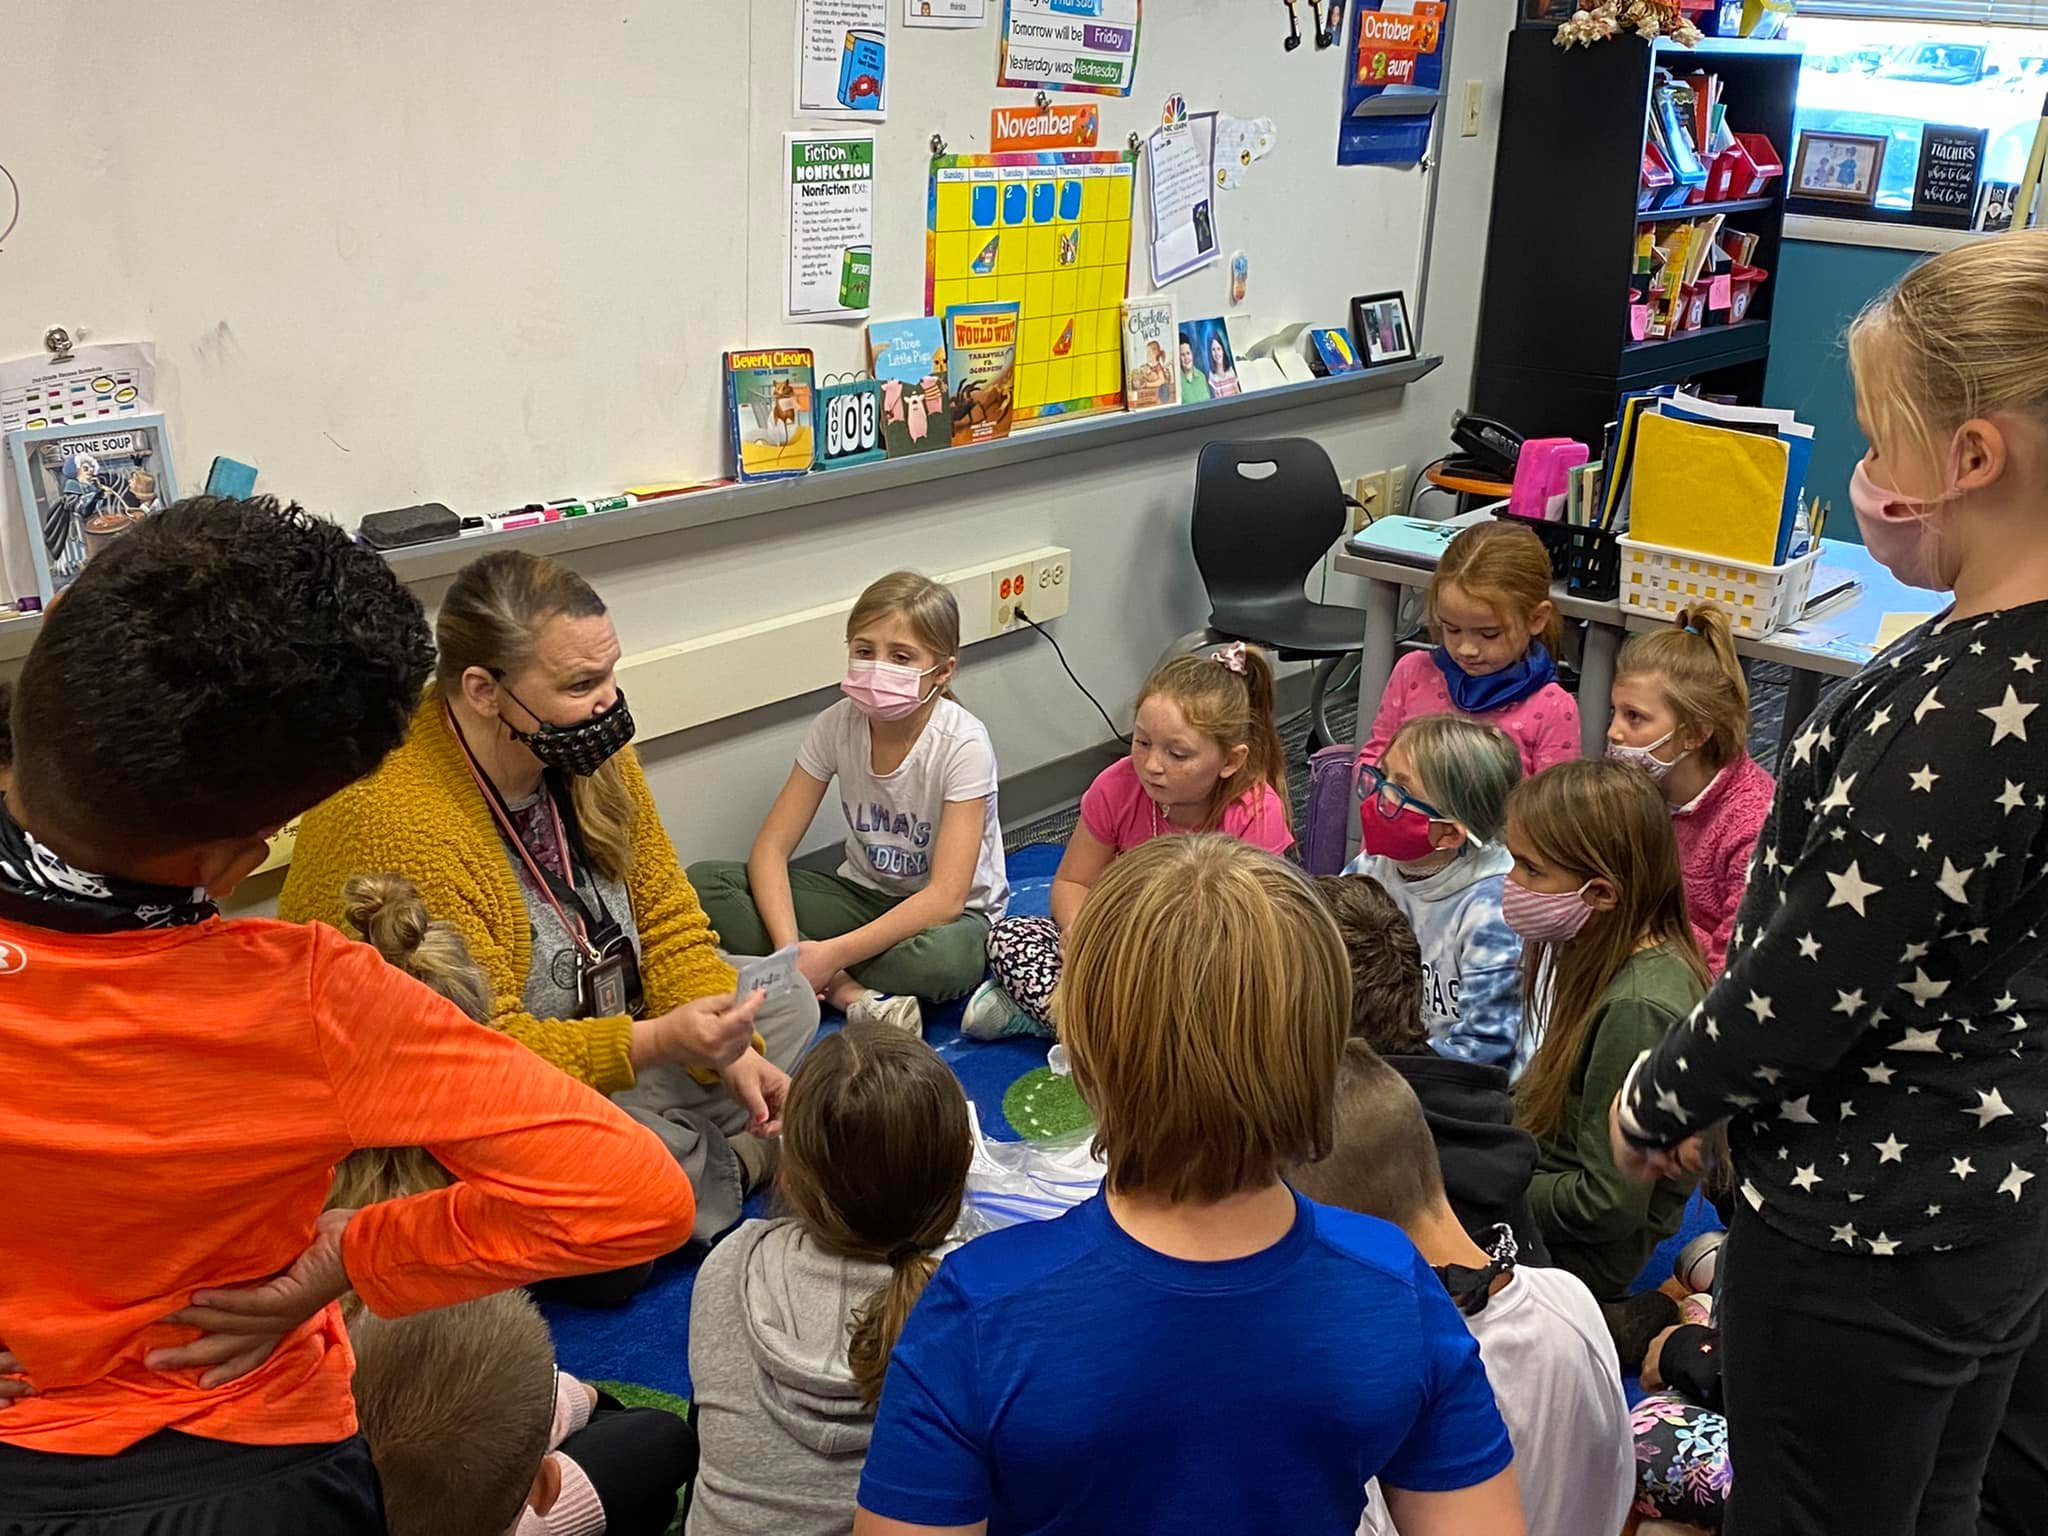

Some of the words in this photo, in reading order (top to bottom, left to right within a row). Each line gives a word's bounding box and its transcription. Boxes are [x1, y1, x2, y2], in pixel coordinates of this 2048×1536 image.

[1011, 19, 1054, 39] Tomorrow
[1054, 25, 1070, 40] will
[1071, 26, 1082, 42] be
[1094, 27, 1123, 48] Friday
[1364, 15, 1414, 42] October
[1009, 54, 1054, 77] Yesterday
[1054, 62, 1073, 75] was
[1075, 60, 1121, 82] Wednesday
[996, 110, 1077, 139] November
[804, 143, 847, 162] Fiction
[796, 163, 871, 181] NONFICTION
[801, 183, 850, 197] Nonfiction
[1006, 186, 1013, 199] 2
[1035, 185, 1041, 197] 3
[892, 337, 921, 351] Three
[955, 324, 993, 347] WOULD
[732, 352, 773, 369] Beverly
[773, 351, 812, 368] Cleary
[887, 351, 913, 367] Little
[912, 350, 931, 366] Pigs
[62, 441, 101, 457] STONE
[102, 436, 132, 451] SOUP
[875, 848, 923, 874] DUTY
